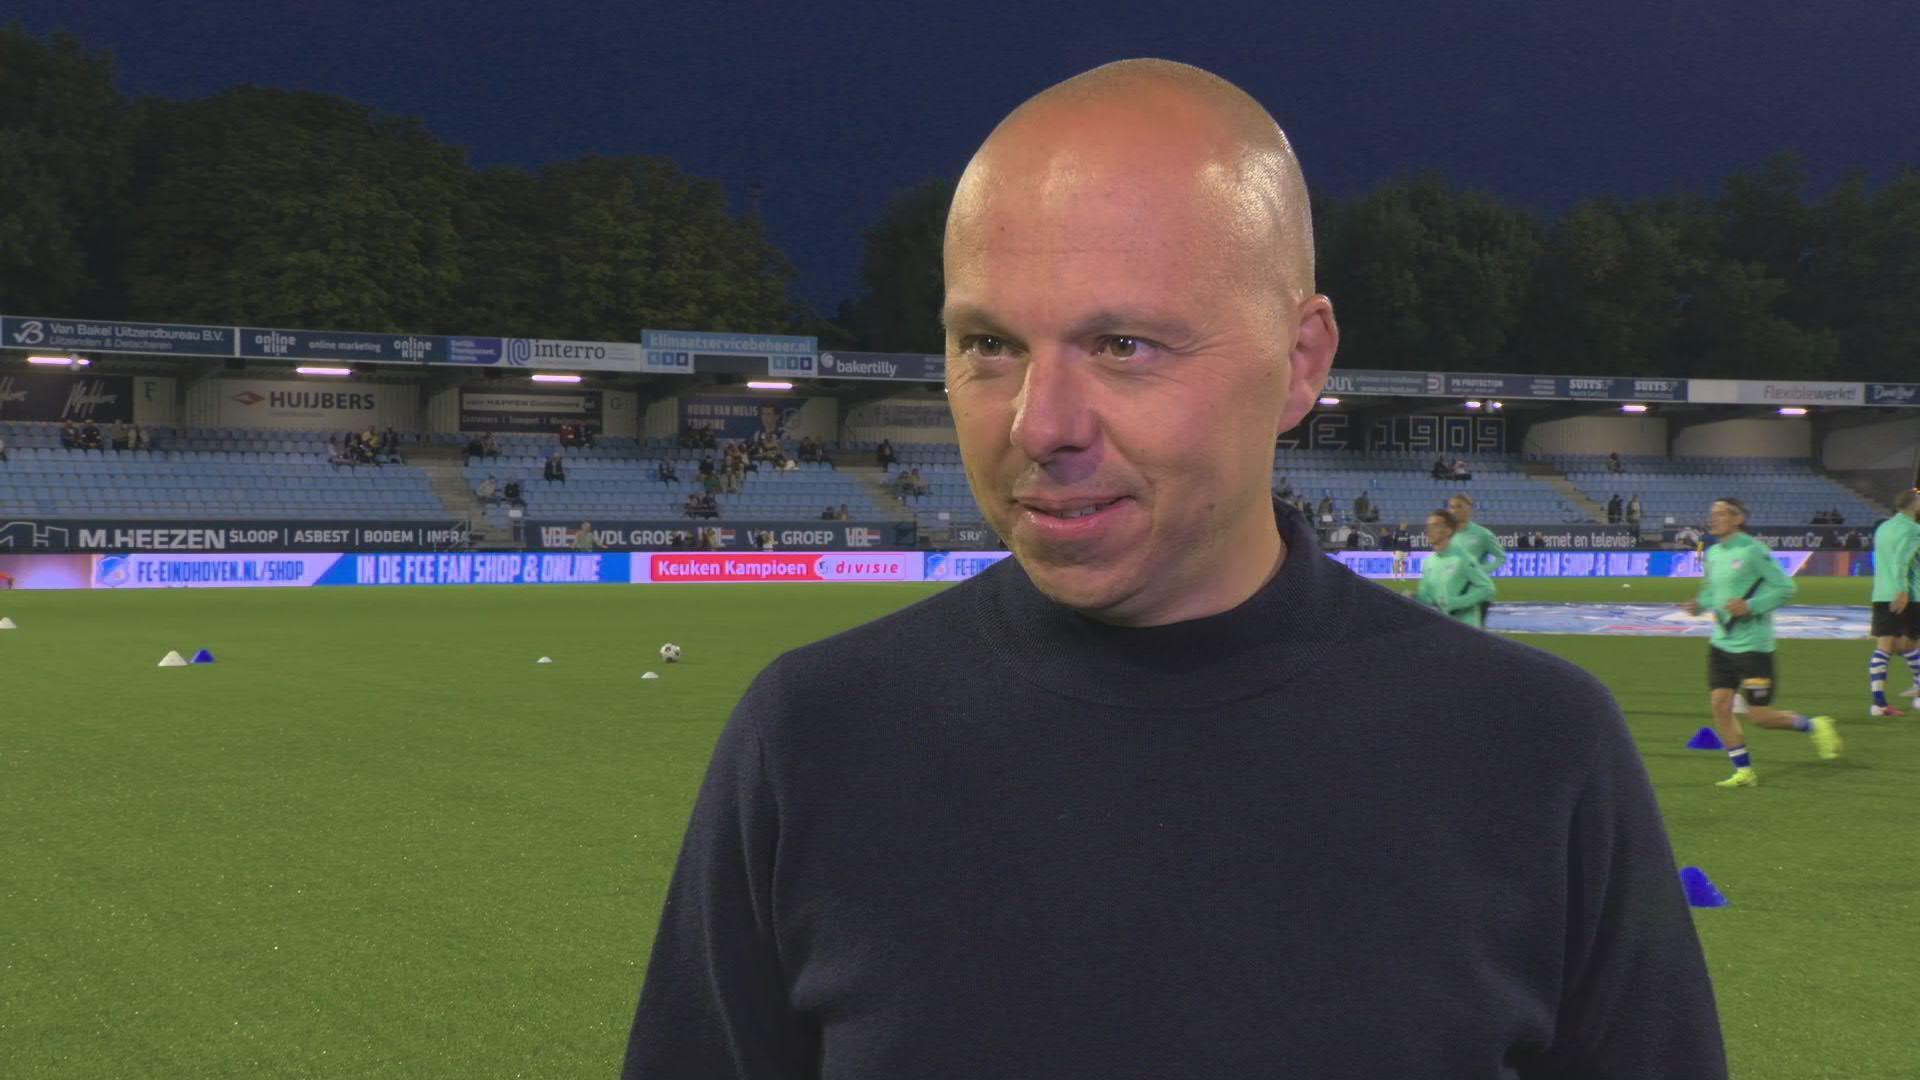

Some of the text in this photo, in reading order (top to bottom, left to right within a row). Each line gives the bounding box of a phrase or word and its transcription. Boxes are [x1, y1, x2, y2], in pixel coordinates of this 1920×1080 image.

[51, 323, 74, 335] Van
[77, 324, 112, 338] Bakel
[115, 326, 200, 341] Uitzendbureau
[535, 339, 606, 360] interro
[836, 360, 897, 377] bakertilly
[270, 391, 375, 410] HUIJBERS
[79, 529, 225, 549] M.HEEZEN
[229, 530, 278, 543] SLOOP
[294, 530, 350, 543] ASBEST
[364, 530, 413, 543] BODEM
[782, 530, 834, 545] GROEP
[1574, 536, 1589, 548] en
[138, 560, 304, 582] FC-EINDHOVEN.NL/SHOP
[357, 554, 600, 583] IN DE FCE FAN SHOP & ONLINE
[658, 560, 899, 578] Keuken Kampioen divisie
